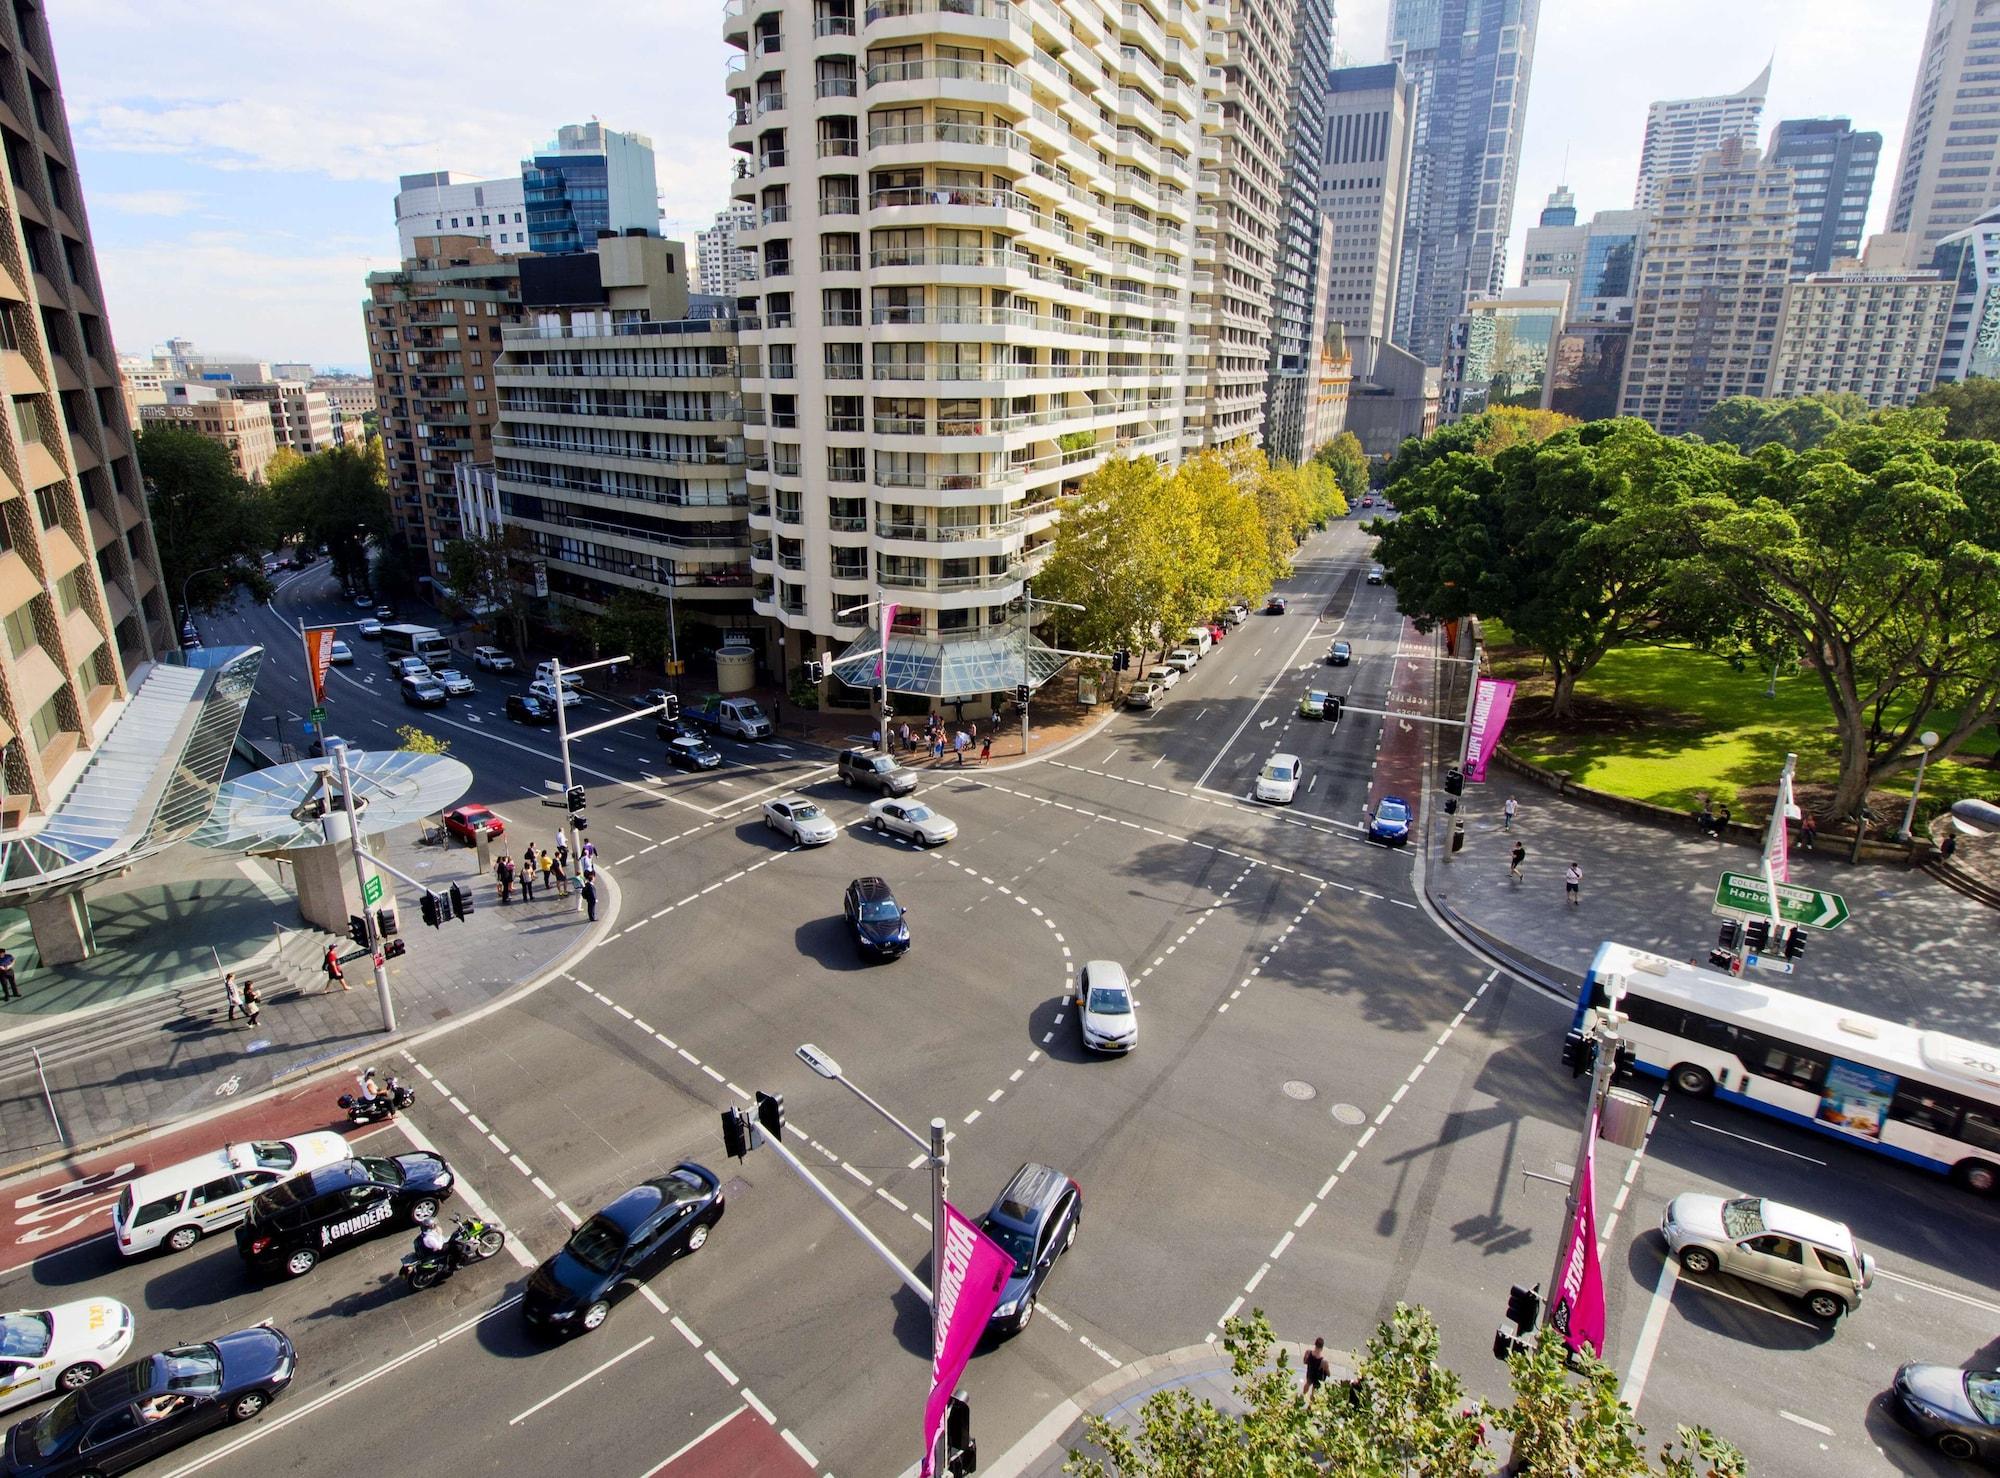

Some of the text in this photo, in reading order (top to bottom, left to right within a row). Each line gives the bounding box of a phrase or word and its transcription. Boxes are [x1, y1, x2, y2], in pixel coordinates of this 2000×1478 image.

[171, 406, 194, 417] TEAS
[366, 879, 379, 889] Surry
[1787, 899, 1806, 912] Br.
[330, 1204, 393, 1240] GRINDERS
[88, 1305, 104, 1330] TAXI
